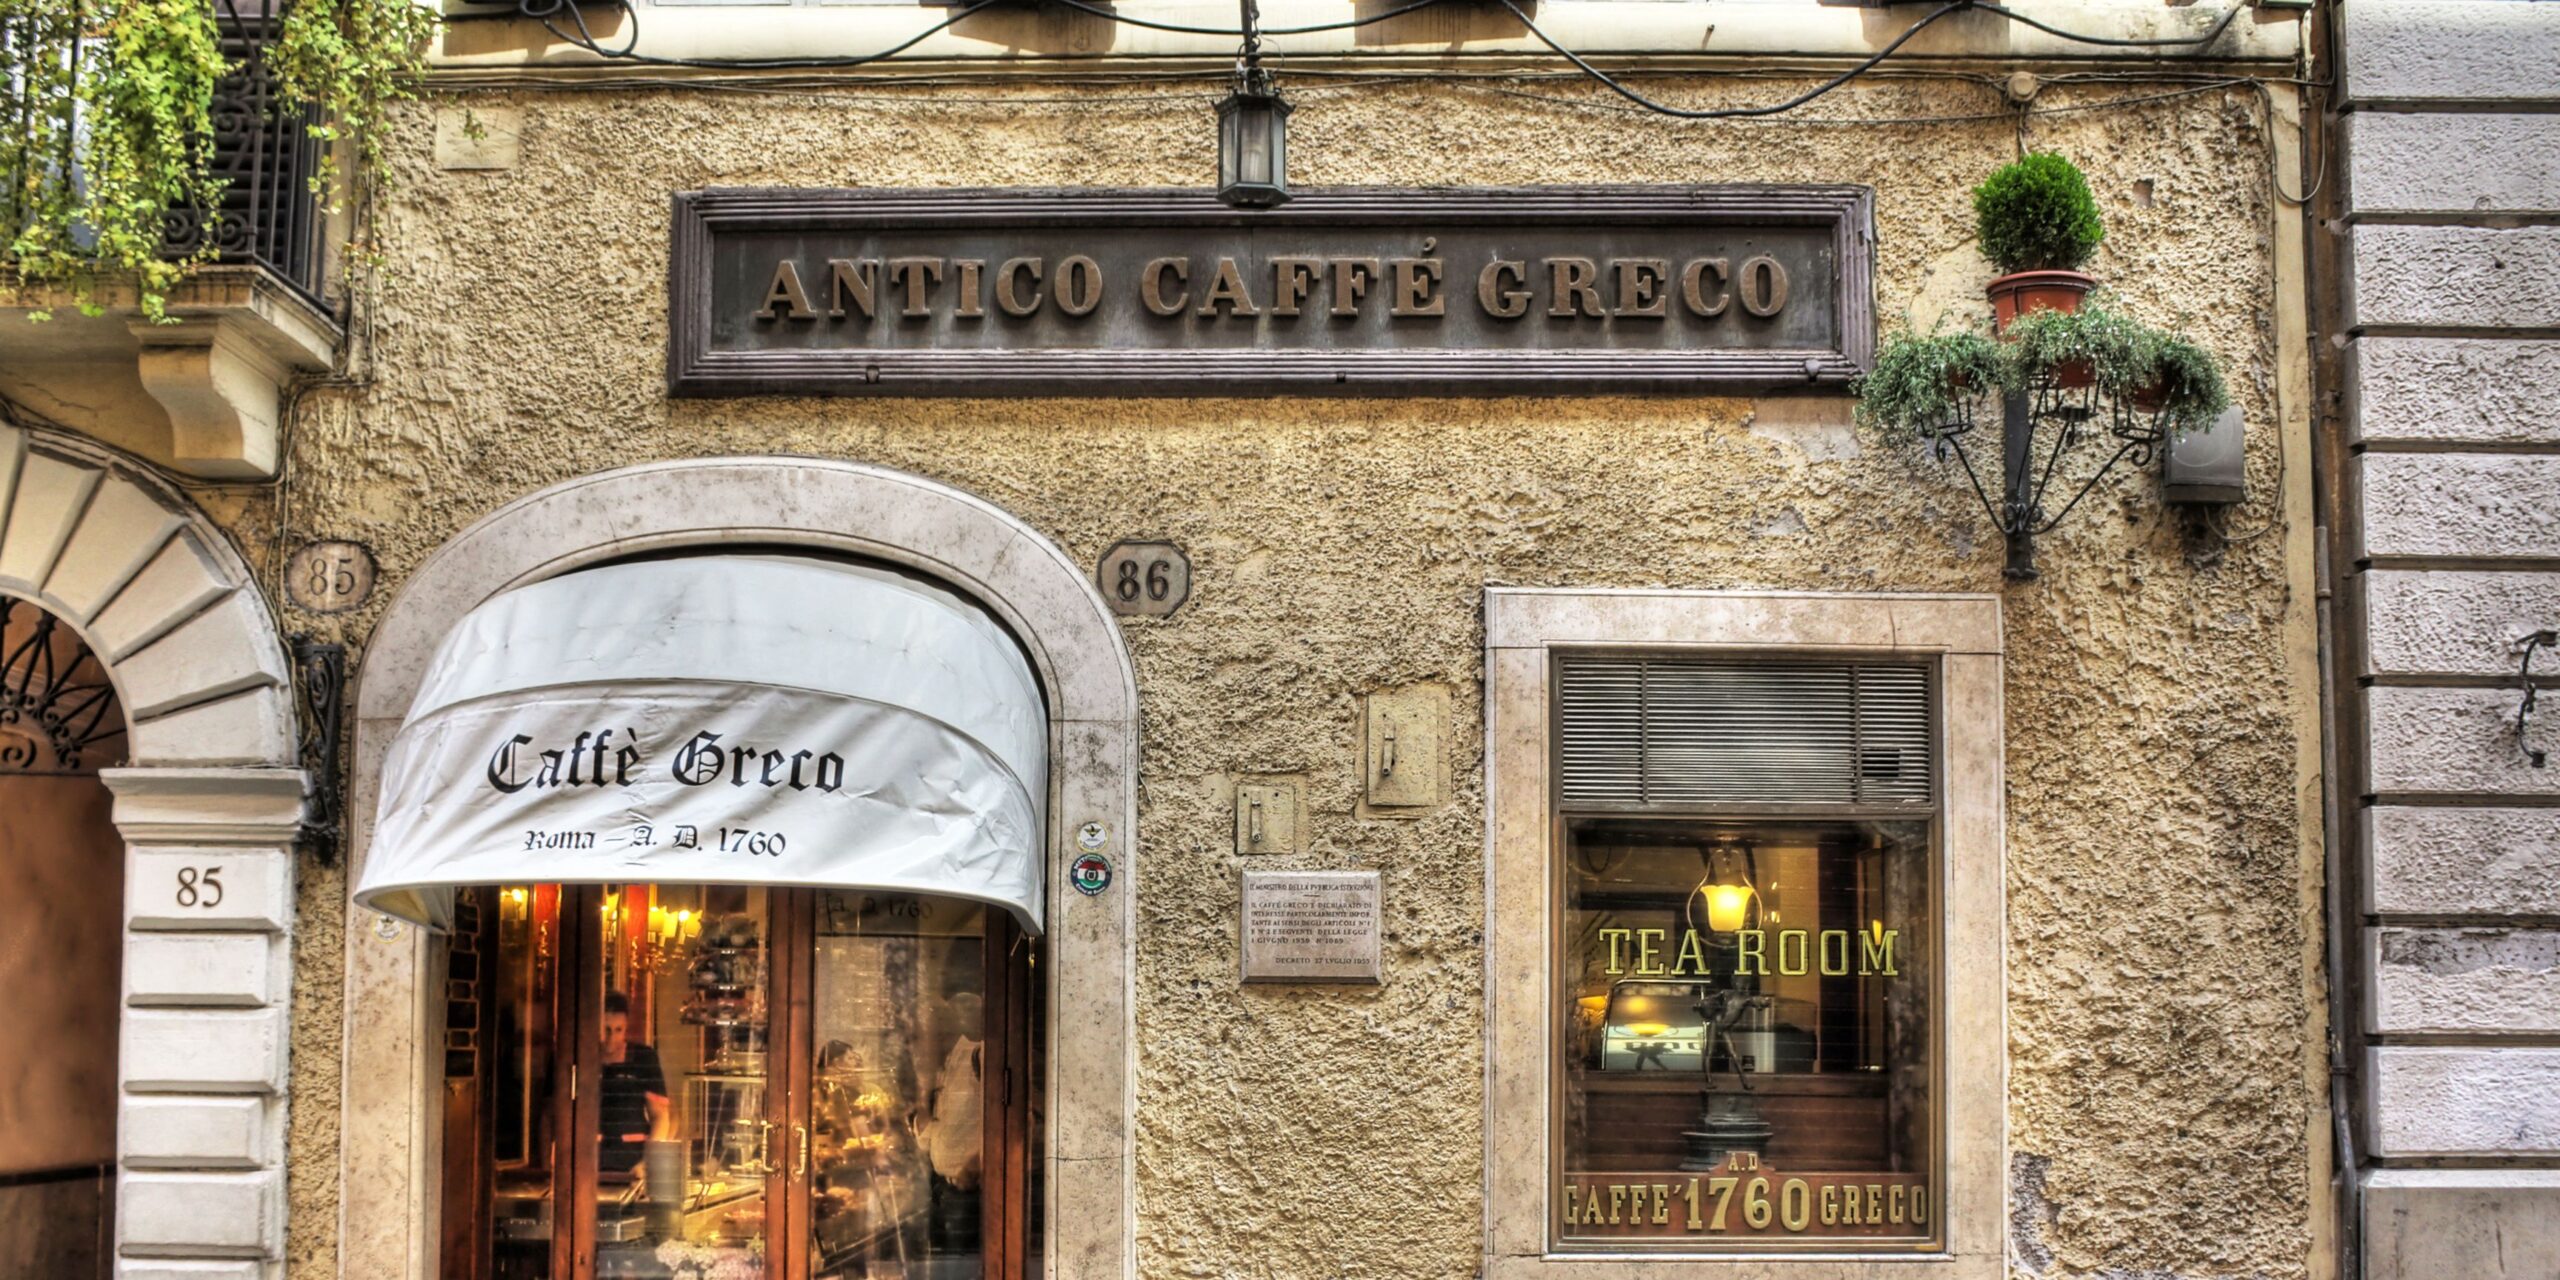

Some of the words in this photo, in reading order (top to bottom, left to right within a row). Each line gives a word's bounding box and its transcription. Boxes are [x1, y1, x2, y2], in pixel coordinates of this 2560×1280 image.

[755, 255, 1103, 318] ANTICO
[1142, 236, 1445, 319] CAFFÉ
[1478, 256, 1789, 318] GRECO
[310, 558, 355, 596] 85
[1117, 560, 1170, 601] 86
[487, 728, 640, 794] Caffè
[672, 729, 844, 793] Greco
[524, 830, 596, 850] Roma
[672, 825, 703, 851] D.
[718, 827, 786, 857] 1760
[176, 865, 223, 908] 85
[1599, 928, 1711, 976] TEA
[1733, 929, 1899, 976] ROOM
[1684, 1177, 1810, 1232] 1760
[1820, 1184, 1927, 1226] GRECO
